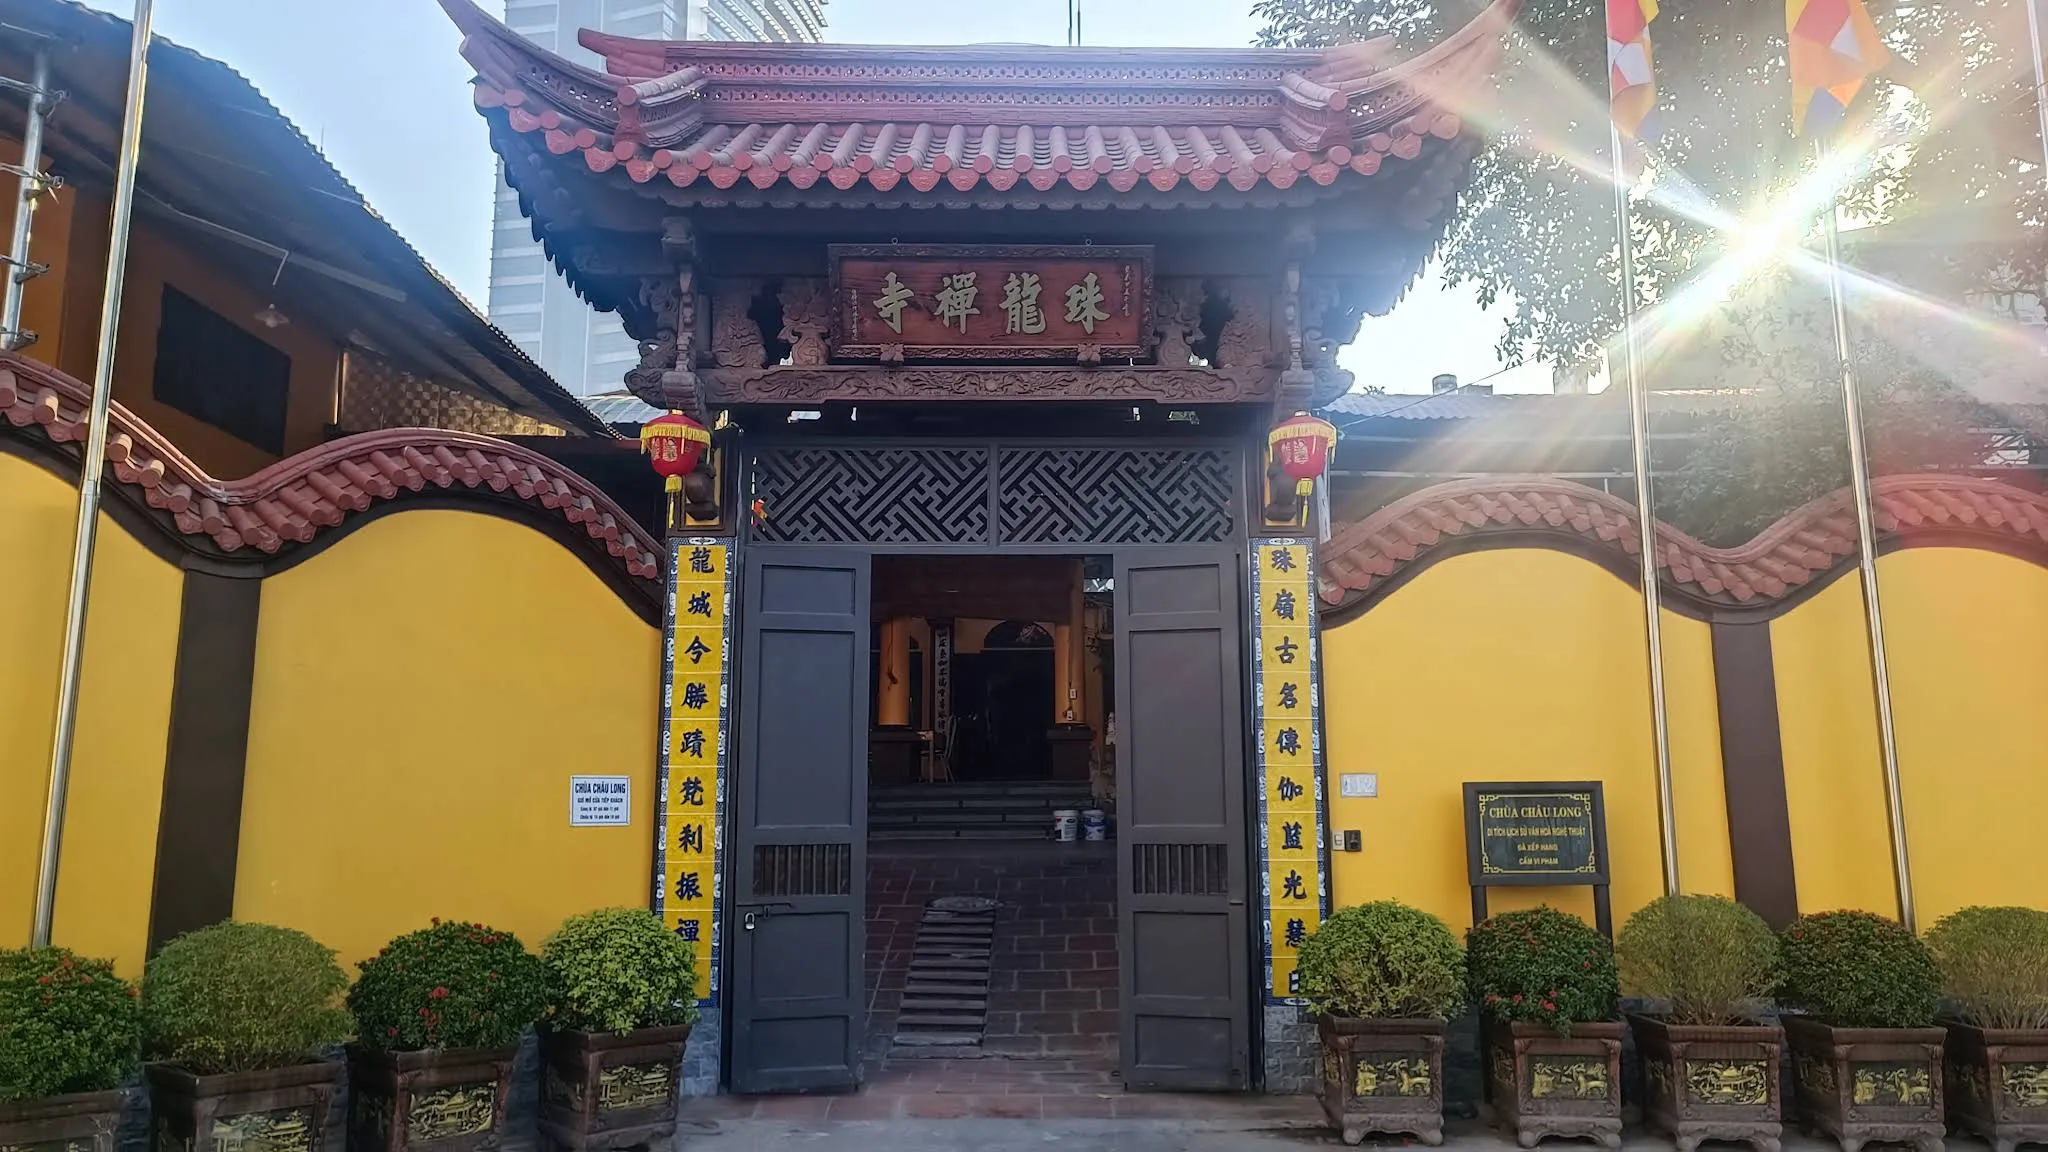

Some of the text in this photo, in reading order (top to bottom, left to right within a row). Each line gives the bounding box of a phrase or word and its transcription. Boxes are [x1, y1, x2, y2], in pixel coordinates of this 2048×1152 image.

[610, 783, 626, 793] LONG
[1489, 804, 1581, 818] CHÙA CHÂU LONG
